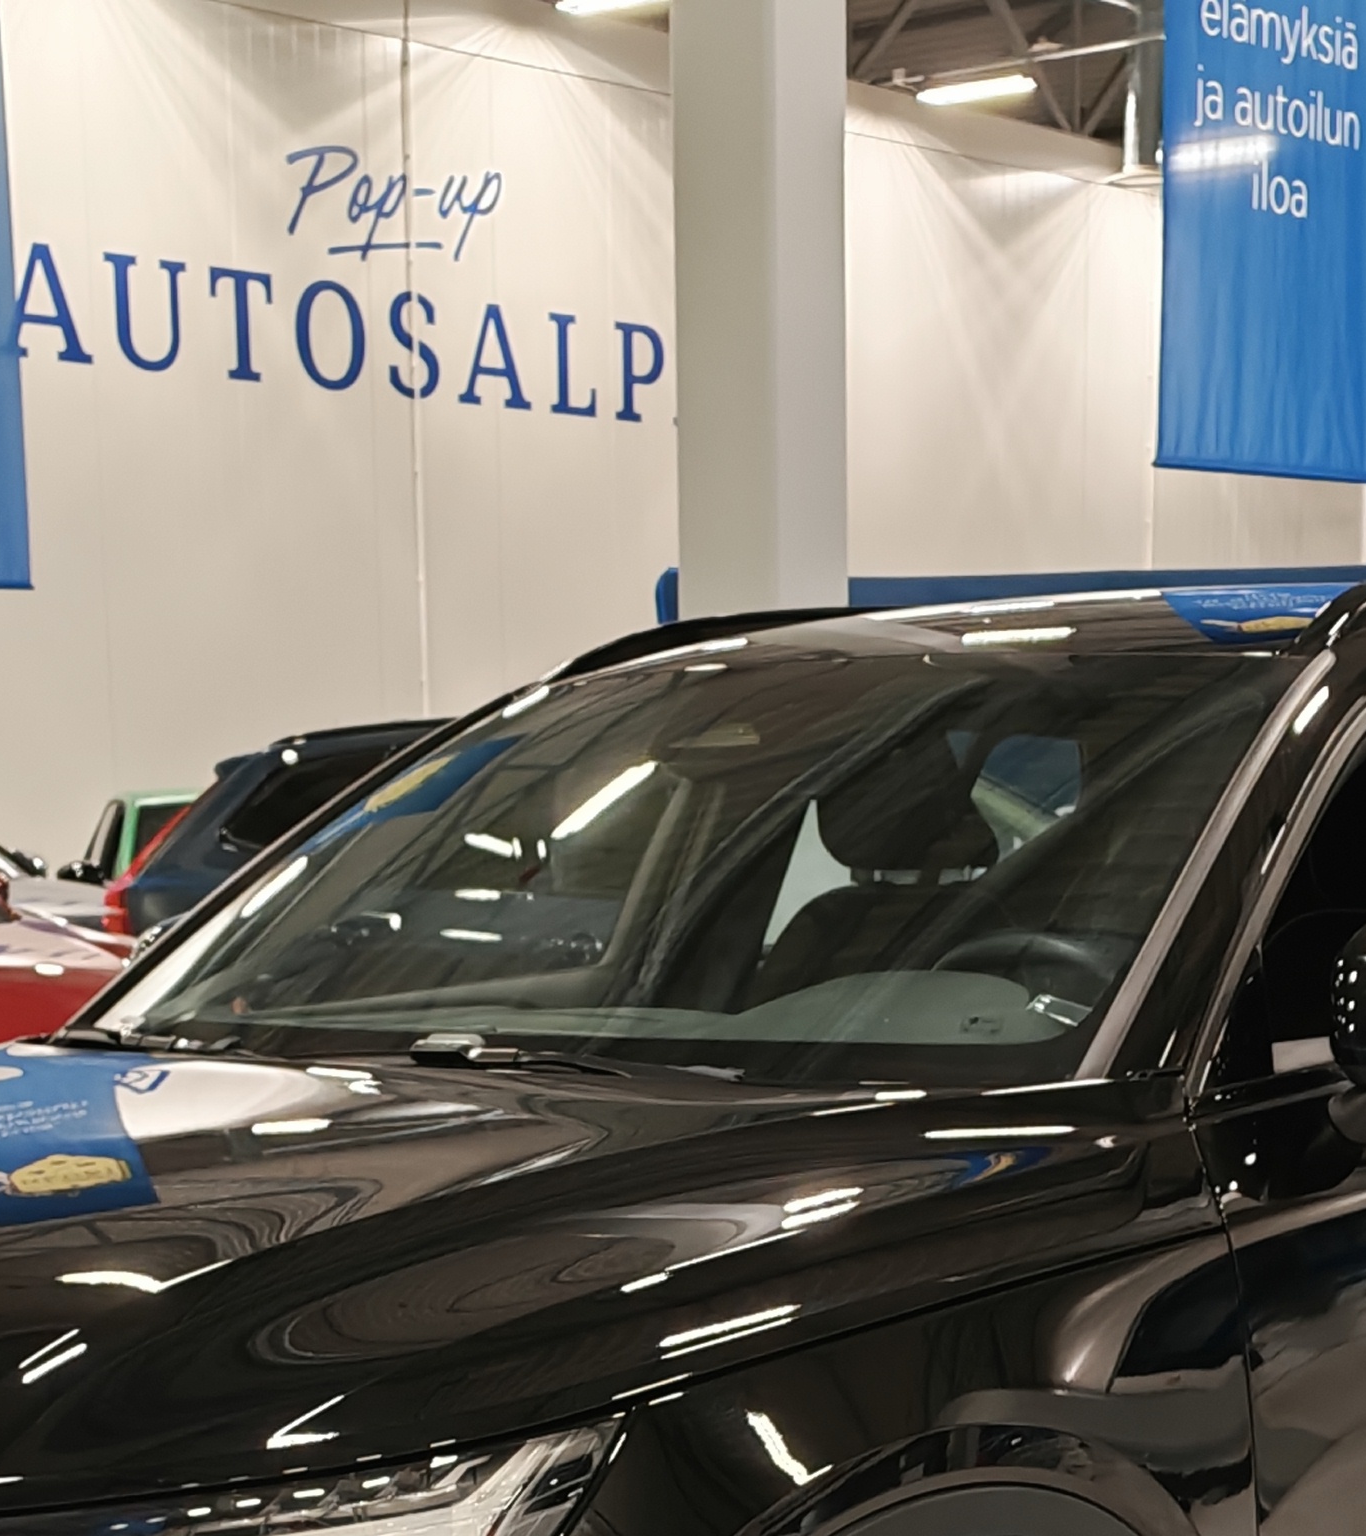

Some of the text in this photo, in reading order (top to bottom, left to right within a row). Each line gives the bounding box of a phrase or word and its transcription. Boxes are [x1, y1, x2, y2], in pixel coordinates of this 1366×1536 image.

[1200, 0, 1358, 70] elämyksiä
[1193, 64, 1361, 151] ja autoilun
[286, 146, 502, 261] Pop-up
[1251, 159, 1309, 218] iloa
[11, 242, 678, 427] AUTOSALP
